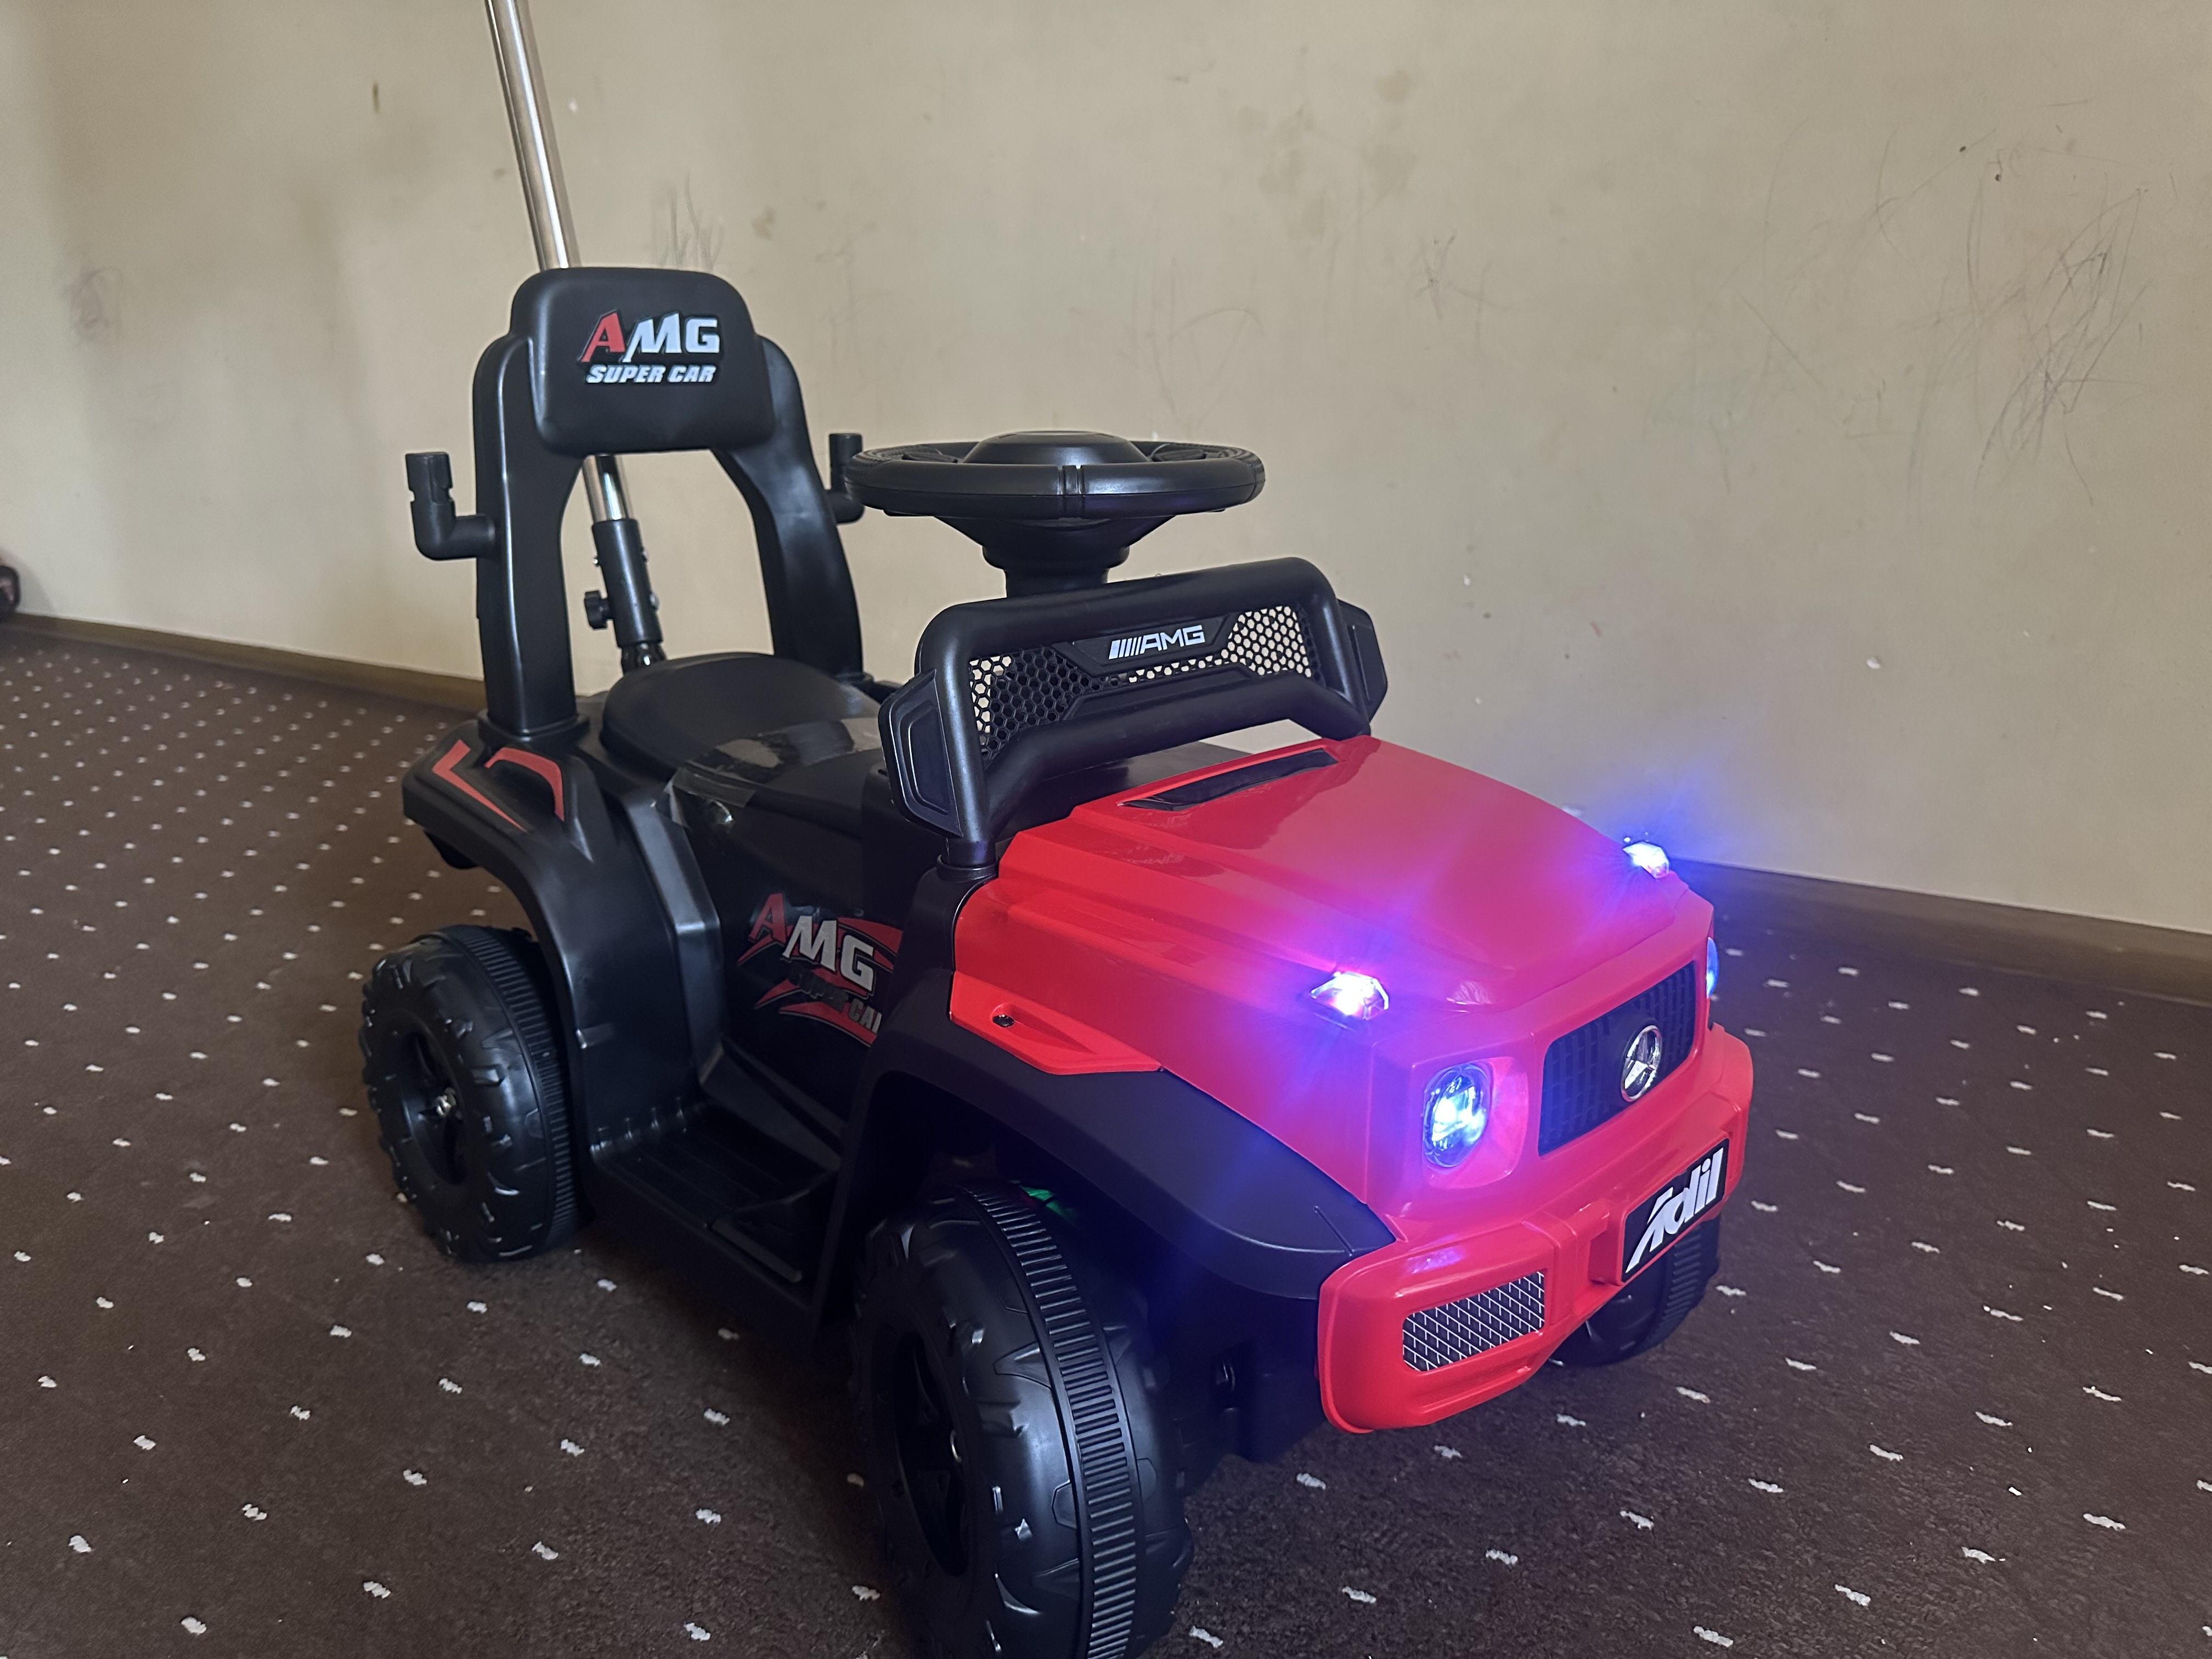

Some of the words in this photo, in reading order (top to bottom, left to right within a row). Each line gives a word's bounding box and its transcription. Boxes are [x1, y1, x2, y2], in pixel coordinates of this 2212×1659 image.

[578, 309, 720, 363] AMG
[586, 365, 666, 383] SUPER
[667, 365, 716, 383] CAR
[748, 892, 874, 992] AMG
